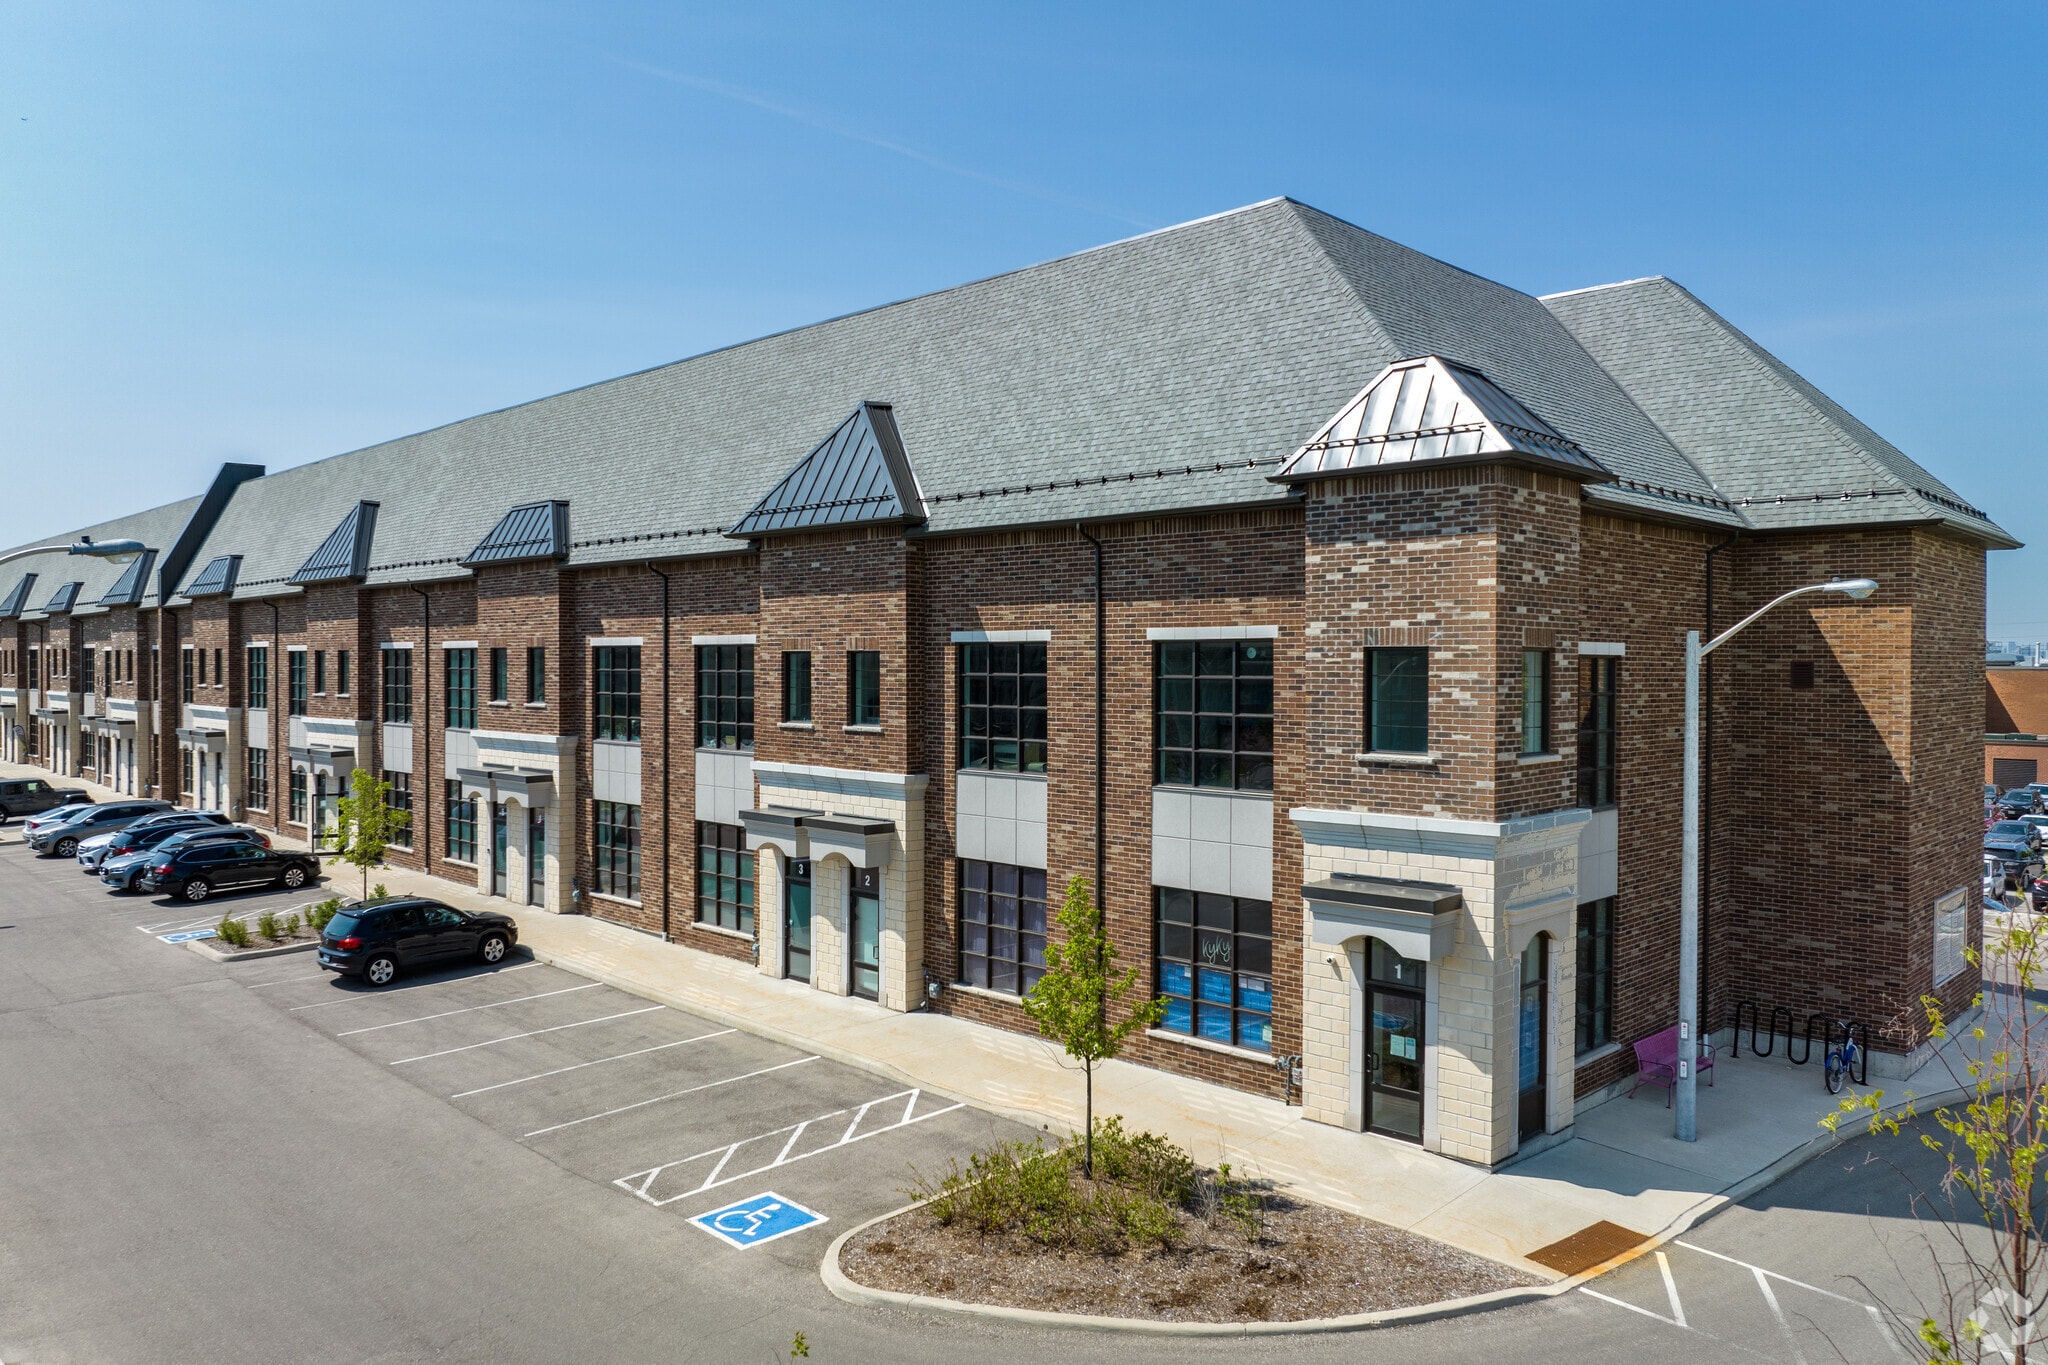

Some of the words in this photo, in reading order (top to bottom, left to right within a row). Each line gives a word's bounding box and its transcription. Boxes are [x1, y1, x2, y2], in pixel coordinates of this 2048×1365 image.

[798, 863, 804, 875] 3
[864, 874, 871, 886] 2
[1394, 963, 1402, 980] 1
